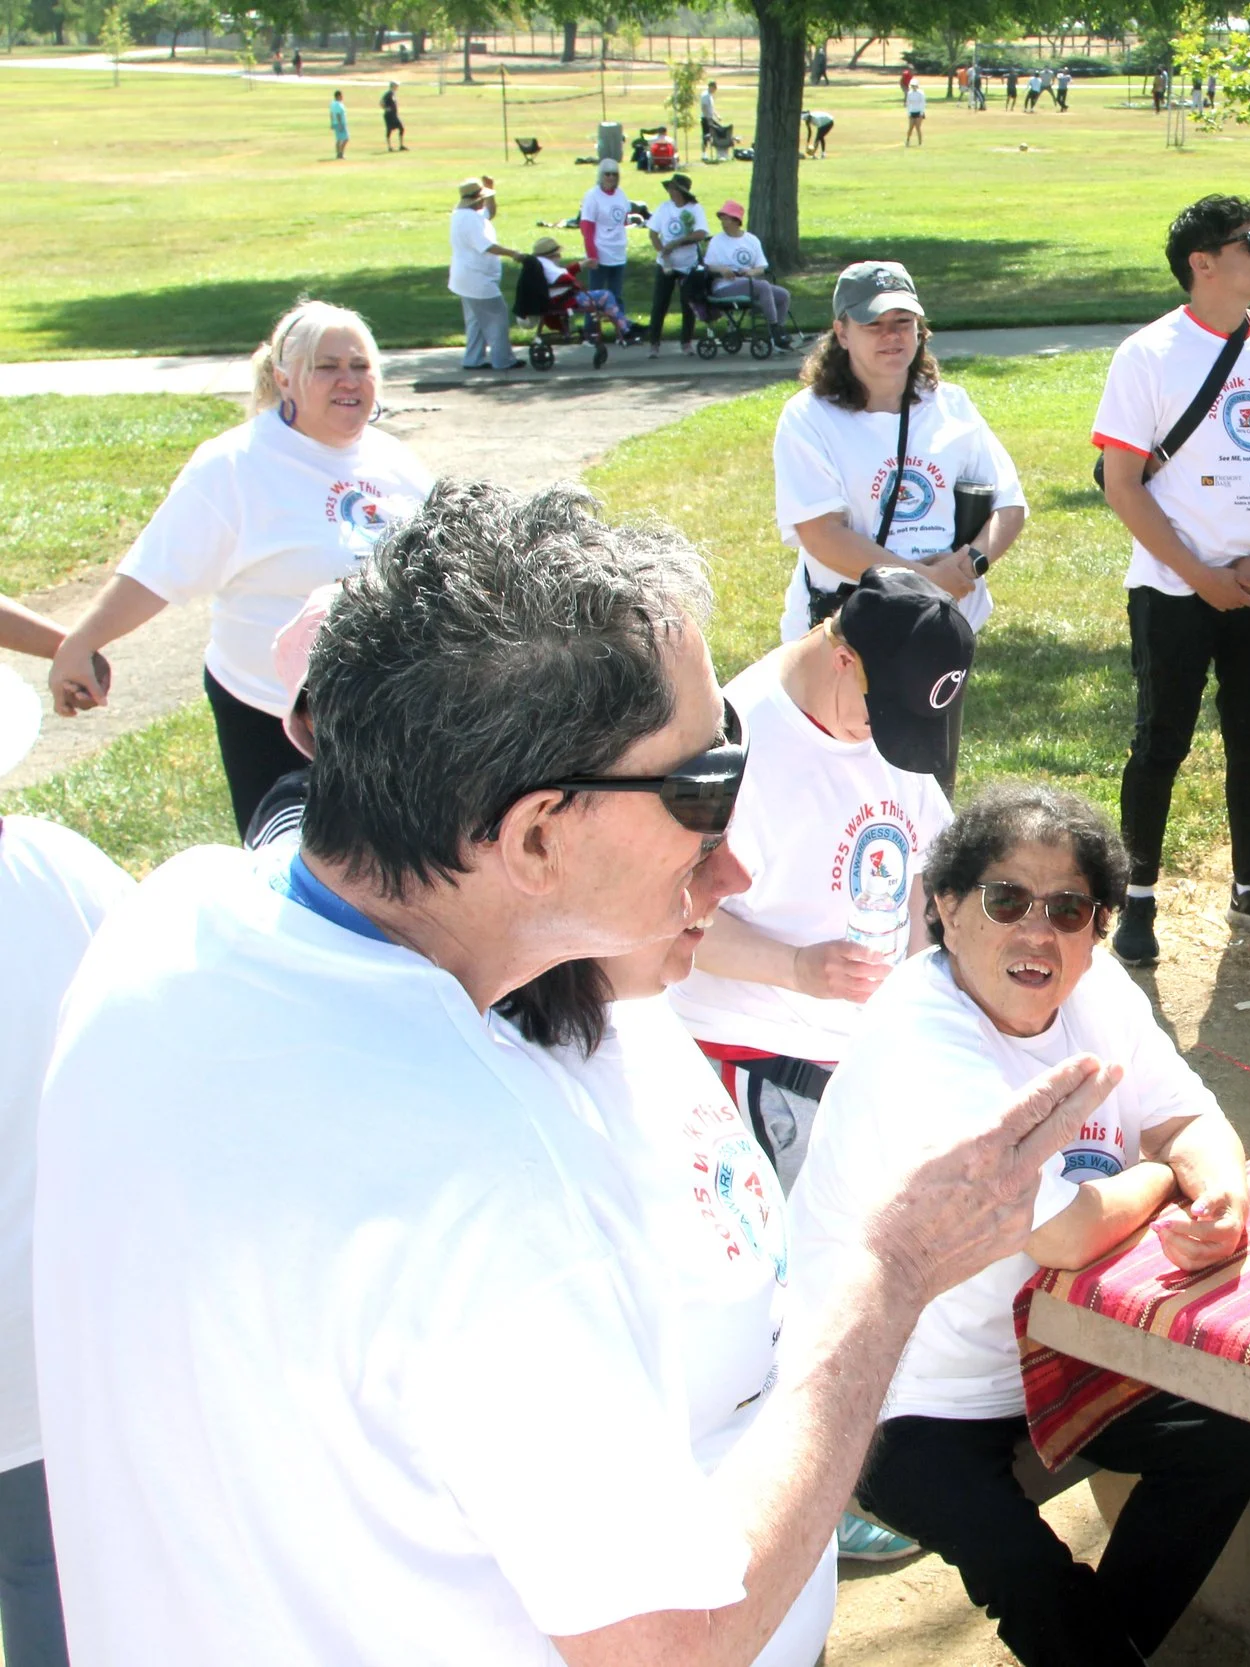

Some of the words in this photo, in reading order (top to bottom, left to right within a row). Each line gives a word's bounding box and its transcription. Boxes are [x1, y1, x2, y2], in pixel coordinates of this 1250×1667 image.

[1219, 454, 1230, 462] See
[358, 480, 382, 498] This
[871, 468, 888, 500] 2025
[905, 455, 924, 467] his
[926, 461, 946, 490] Way
[831, 842, 850, 892] 2025
[845, 803, 875, 839] Walk
[880, 800, 905, 822] This
[853, 828, 890, 878] AWARENESS
[692, 1103, 736, 1129] This
[1080, 1121, 1106, 1141] his
[1091, 1155, 1115, 1173] WAL
